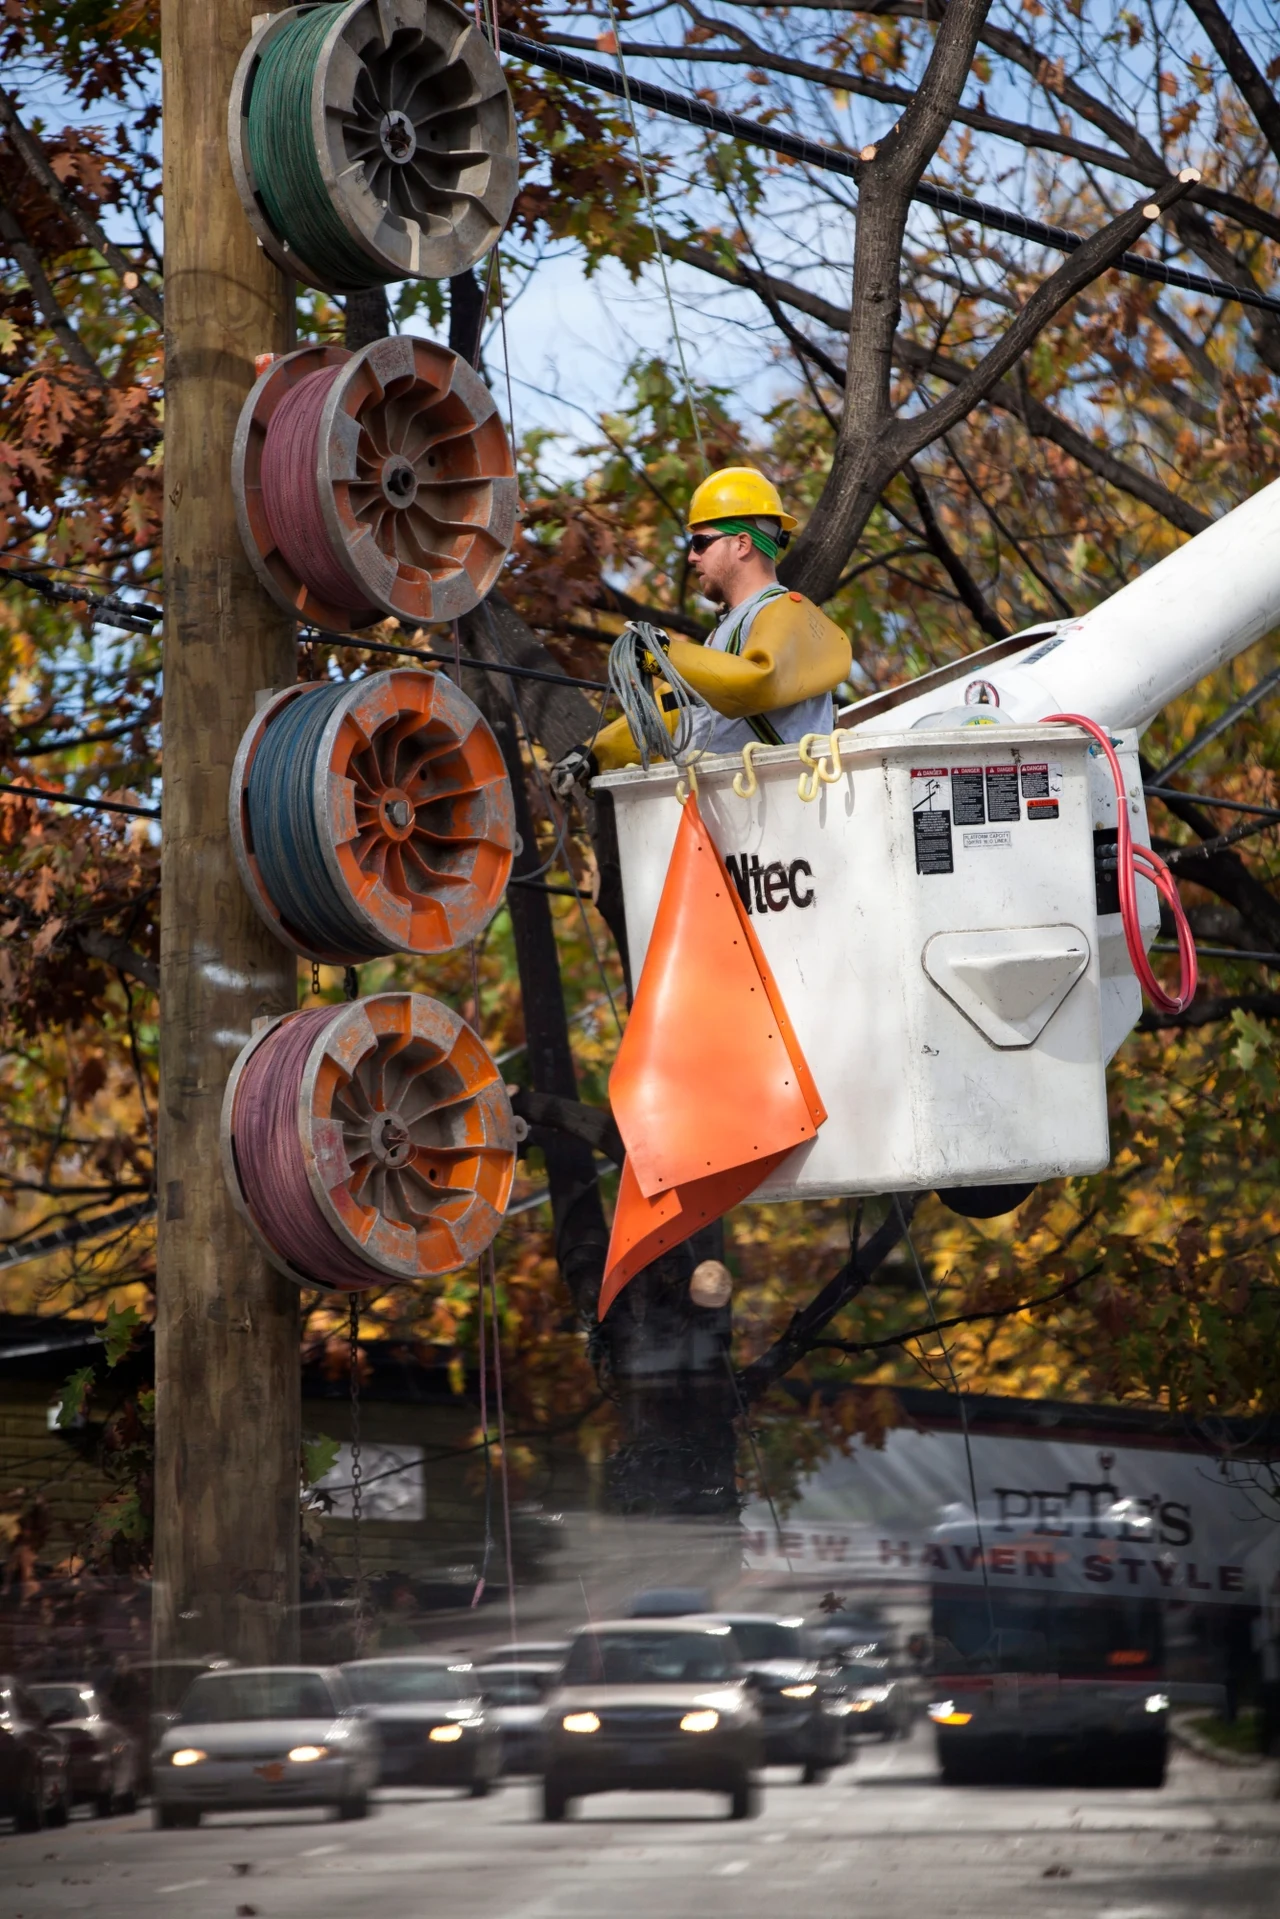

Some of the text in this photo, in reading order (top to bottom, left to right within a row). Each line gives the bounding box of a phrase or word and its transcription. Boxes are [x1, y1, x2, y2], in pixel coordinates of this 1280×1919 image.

[1026, 764, 1047, 772] DANGER
[740, 1529, 851, 1563] NEW
[878, 1538, 1057, 1579] HAVEN
[1085, 1553, 1246, 1593] STYLE
